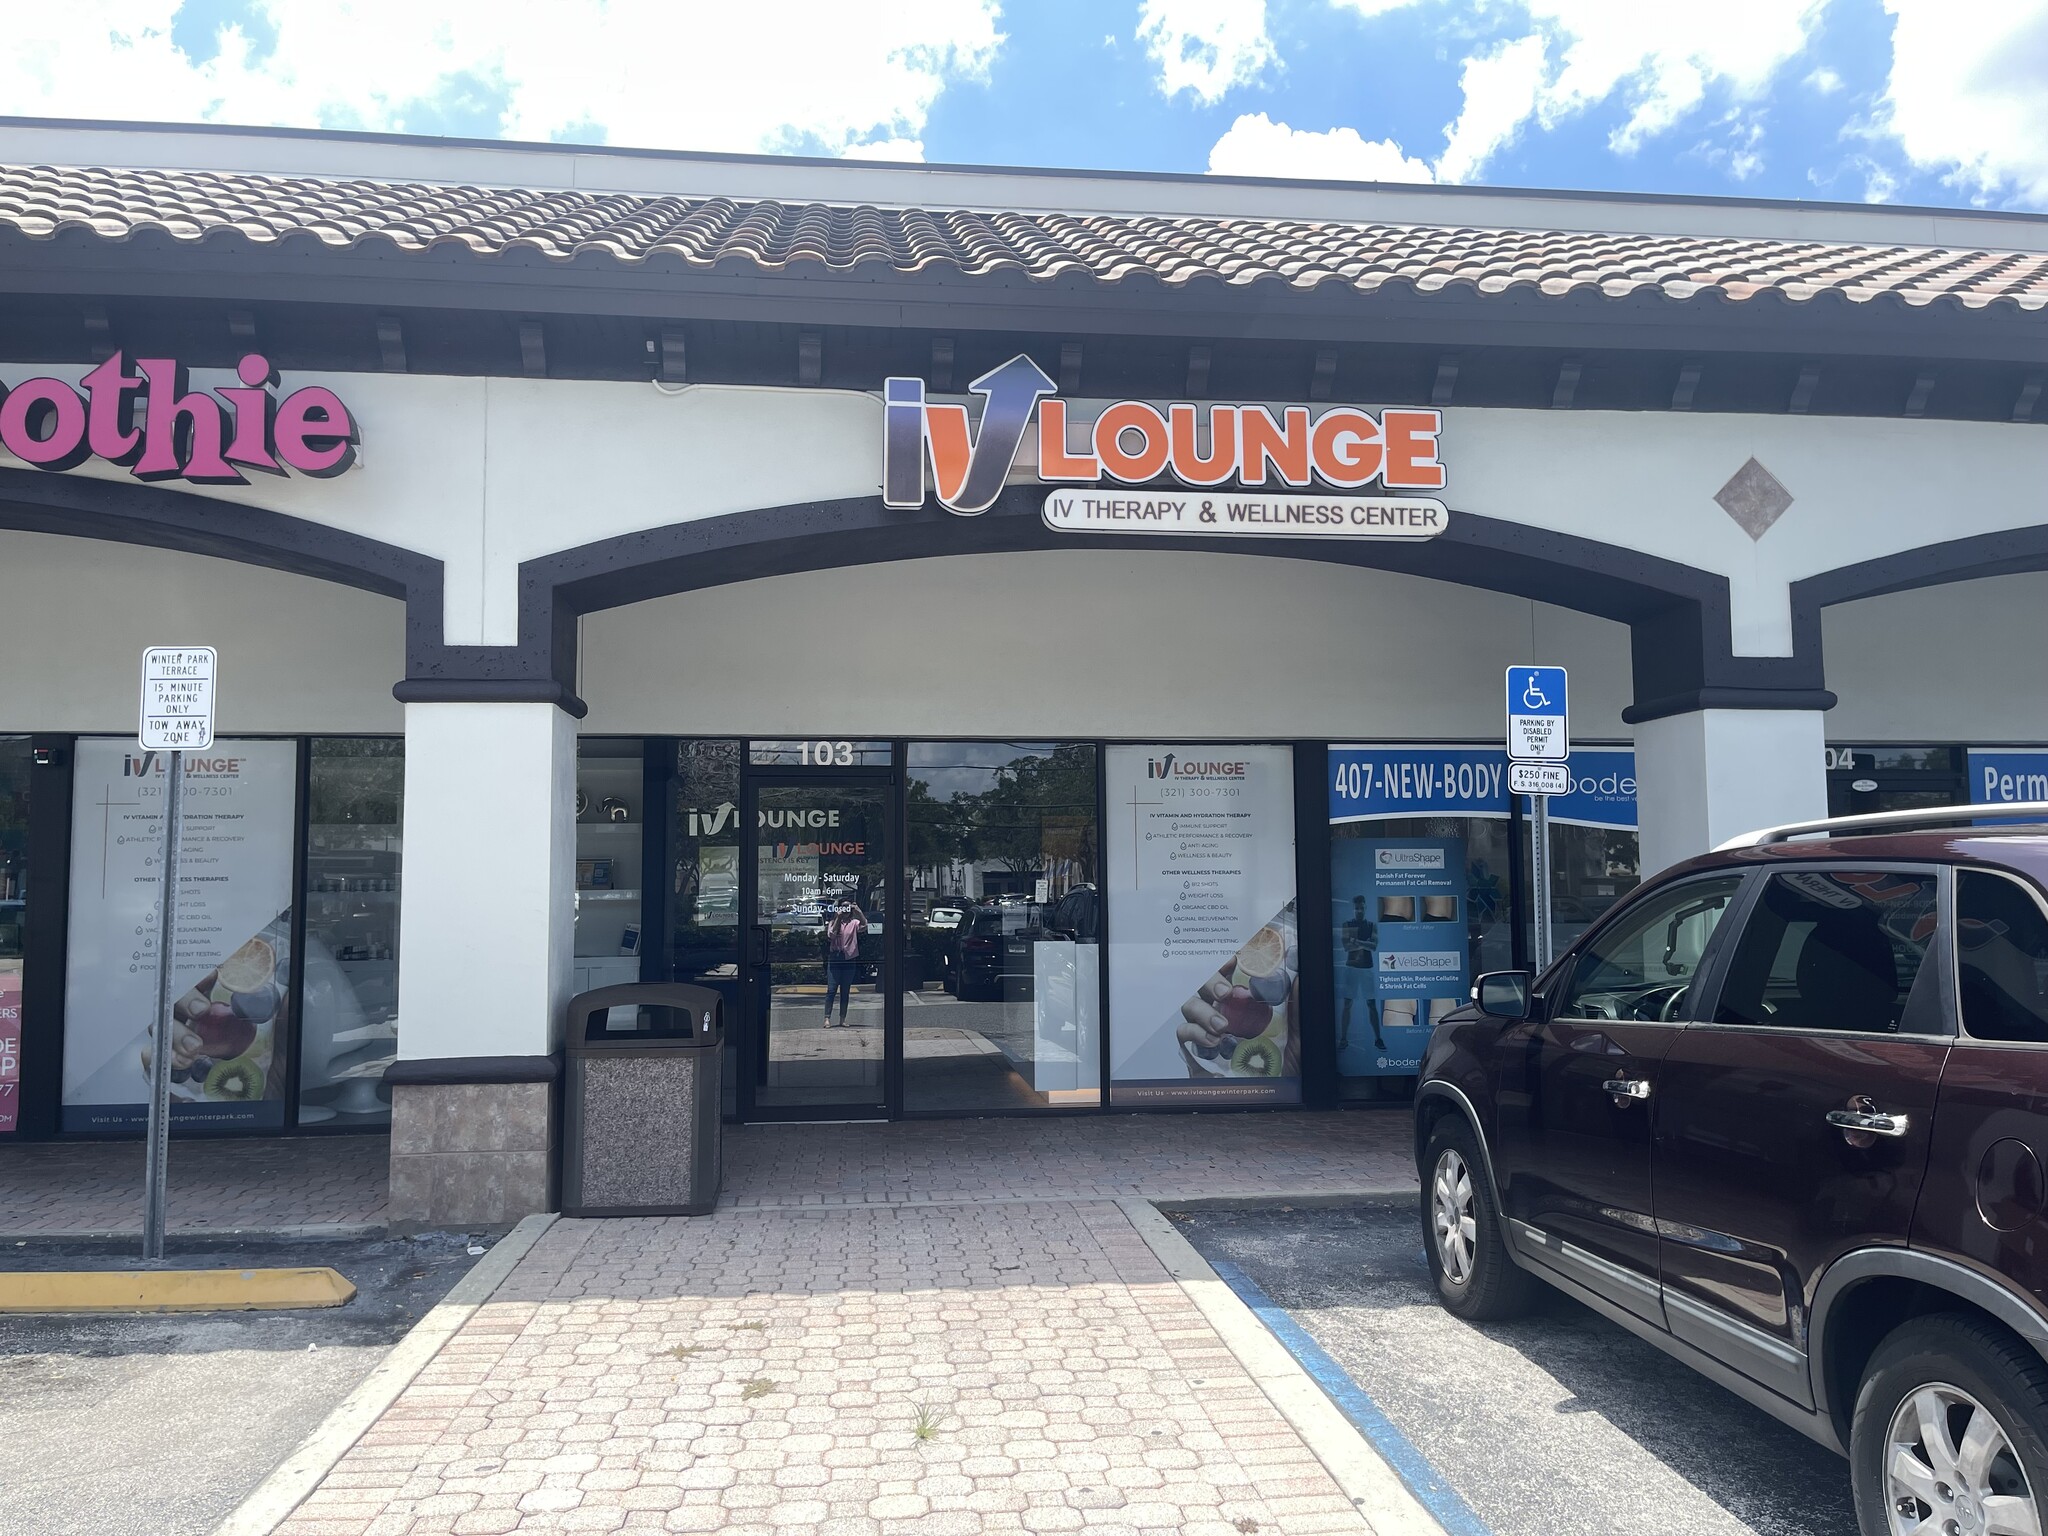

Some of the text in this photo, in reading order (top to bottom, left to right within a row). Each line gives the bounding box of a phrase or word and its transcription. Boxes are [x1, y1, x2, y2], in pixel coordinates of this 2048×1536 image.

[1038, 398, 1448, 488] LOUNGE
[1052, 500, 1438, 526] IV THERAPY & WELLNESS CENTER
[151, 654, 209, 664] WINTER PARK
[162, 666, 198, 675] TERRACE
[154, 682, 203, 692] 15 MINUTE
[158, 694, 198, 702] PARKING
[166, 704, 190, 714] ONLY
[149, 720, 204, 730] TOW AWAY
[1520, 719, 1545, 727] PARKING
[163, 732, 189, 742] ZONE
[1526, 736, 1548, 744] PERMIT
[796, 740, 854, 766] 103
[1530, 744, 1546, 752] ONLY
[155, 758, 239, 773] LUNGE
[1174, 762, 1245, 775] LOUNGE
[1518, 770, 1560, 780] $250 FINE
[1334, 762, 1502, 800] 407-NEW-BODY
[1160, 788, 1240, 798] (321) 300-7301
[797, 842, 865, 855] LOUNGE
[1394, 852, 1441, 865] UltraShape
[784, 872, 860, 884] Monday Saturday
[801, 887, 842, 896] 10am 6pm
[792, 904, 851, 914] Sunday Closed
[1397, 956, 1452, 968] VelaShape
[1171, 1088, 1276, 1096] www.ivloungewinterpark.com
